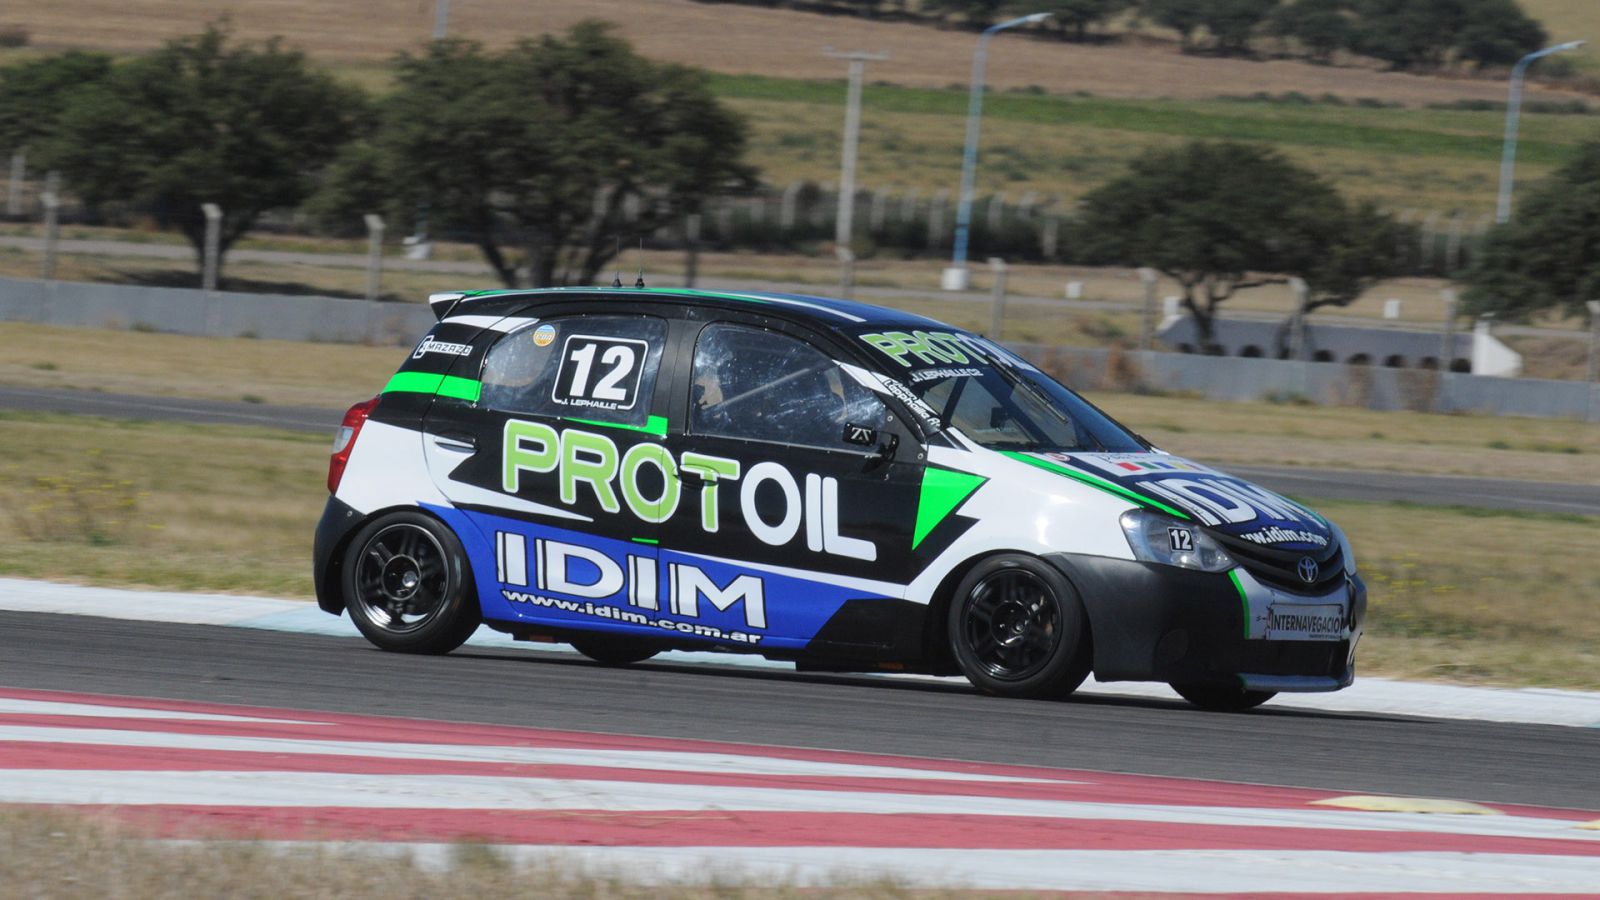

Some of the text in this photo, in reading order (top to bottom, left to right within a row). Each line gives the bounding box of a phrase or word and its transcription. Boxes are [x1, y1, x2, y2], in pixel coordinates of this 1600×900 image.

[569, 343, 635, 400] 12
[858, 331, 1041, 373] PROTOIL
[503, 419, 878, 562] PROTOIL
[1135, 478, 1328, 529] IDIM
[1170, 528, 1193, 551] 12
[495, 531, 768, 629] IDIM
[502, 590, 762, 645] www.idim.com.ar
